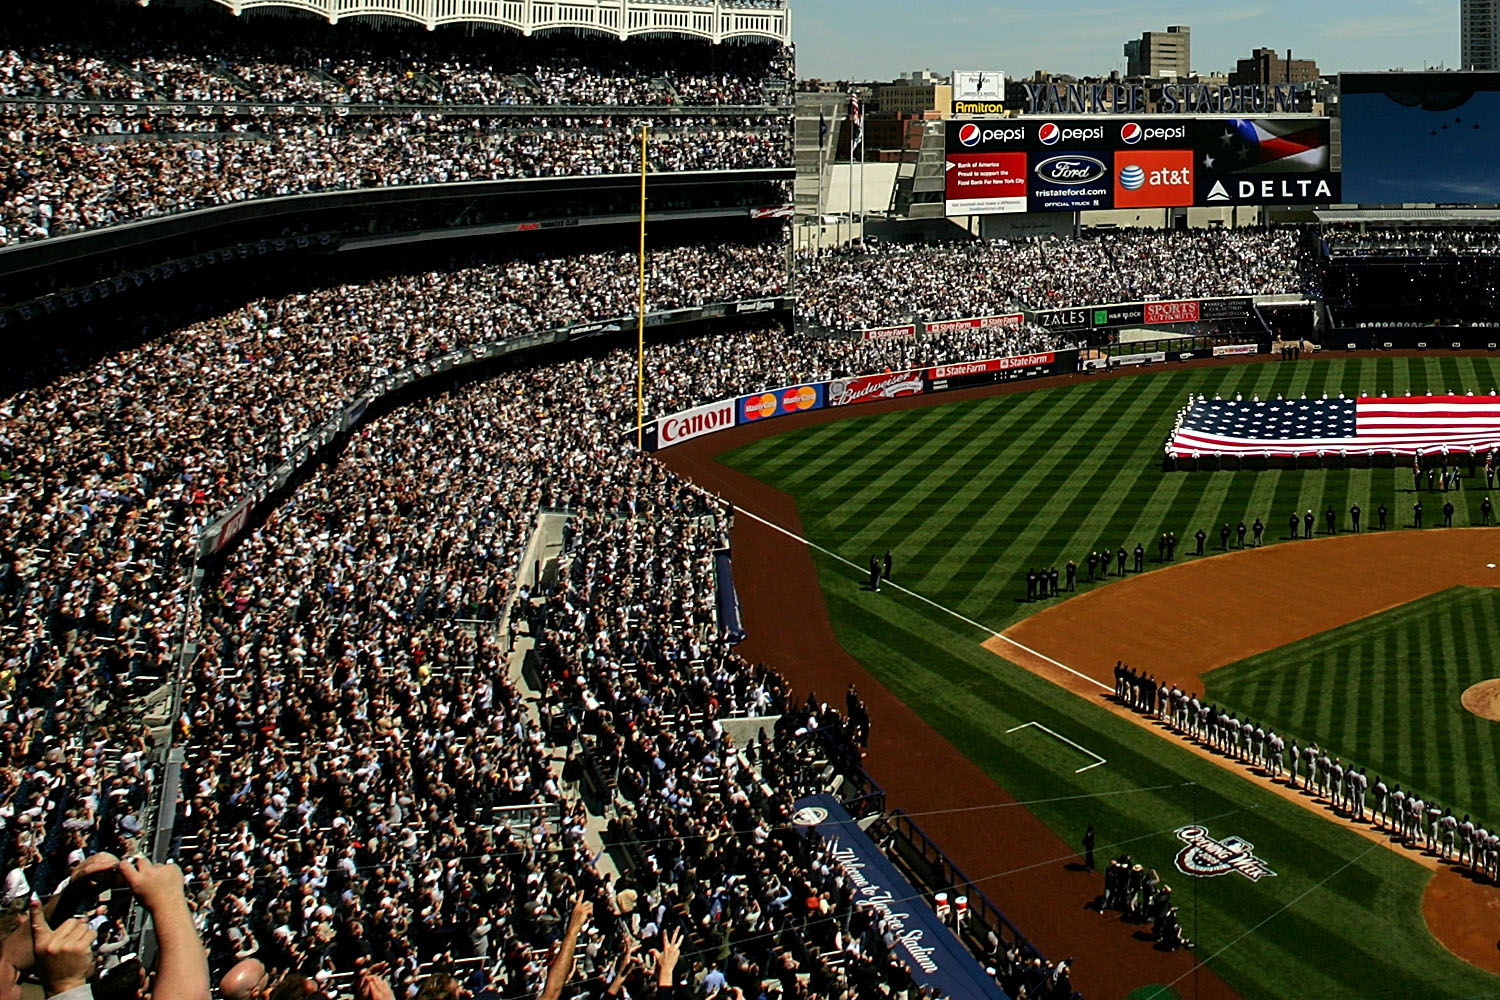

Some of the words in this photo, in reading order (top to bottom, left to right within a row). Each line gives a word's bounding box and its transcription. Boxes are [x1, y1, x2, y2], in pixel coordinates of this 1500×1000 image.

[1023, 83, 1145, 114] YANKEE
[1162, 84, 1298, 114] STADIUM
[956, 102, 1003, 113] Armitron
[983, 127, 1025, 143] pepsi
[1062, 126, 1104, 141] pepsi
[1144, 125, 1186, 140] pepsi
[1051, 161, 1091, 179] Ford
[1149, 166, 1190, 185] at&t
[1035, 188, 1107, 198] tristateford.com
[1239, 180, 1332, 198] DELTA
[1148, 303, 1197, 315] SPORTS
[939, 323, 955, 331] State
[956, 321, 971, 329] Farm
[989, 318, 1004, 326] State
[1004, 316, 1019, 324] Farm
[1043, 311, 1085, 326] ZALES
[894, 328, 909, 336] Farm
[1009, 357, 1028, 367] State
[1028, 354, 1047, 364] Farm
[945, 365, 965, 376] State
[965, 363, 986, 373] Farm
[834, 372, 911, 406] Budweiser
[783, 392, 816, 405] MasterCard
[745, 401, 777, 413] MasterCard
[662, 407, 731, 441] Canon
[1180, 828, 1233, 860] OPENING
[1227, 852, 1268, 879] WEEK
[831, 848, 869, 888] Welcome
[862, 884, 880, 897] to
[856, 890, 909, 931] Yankee
[895, 929, 938, 974] Stadium
